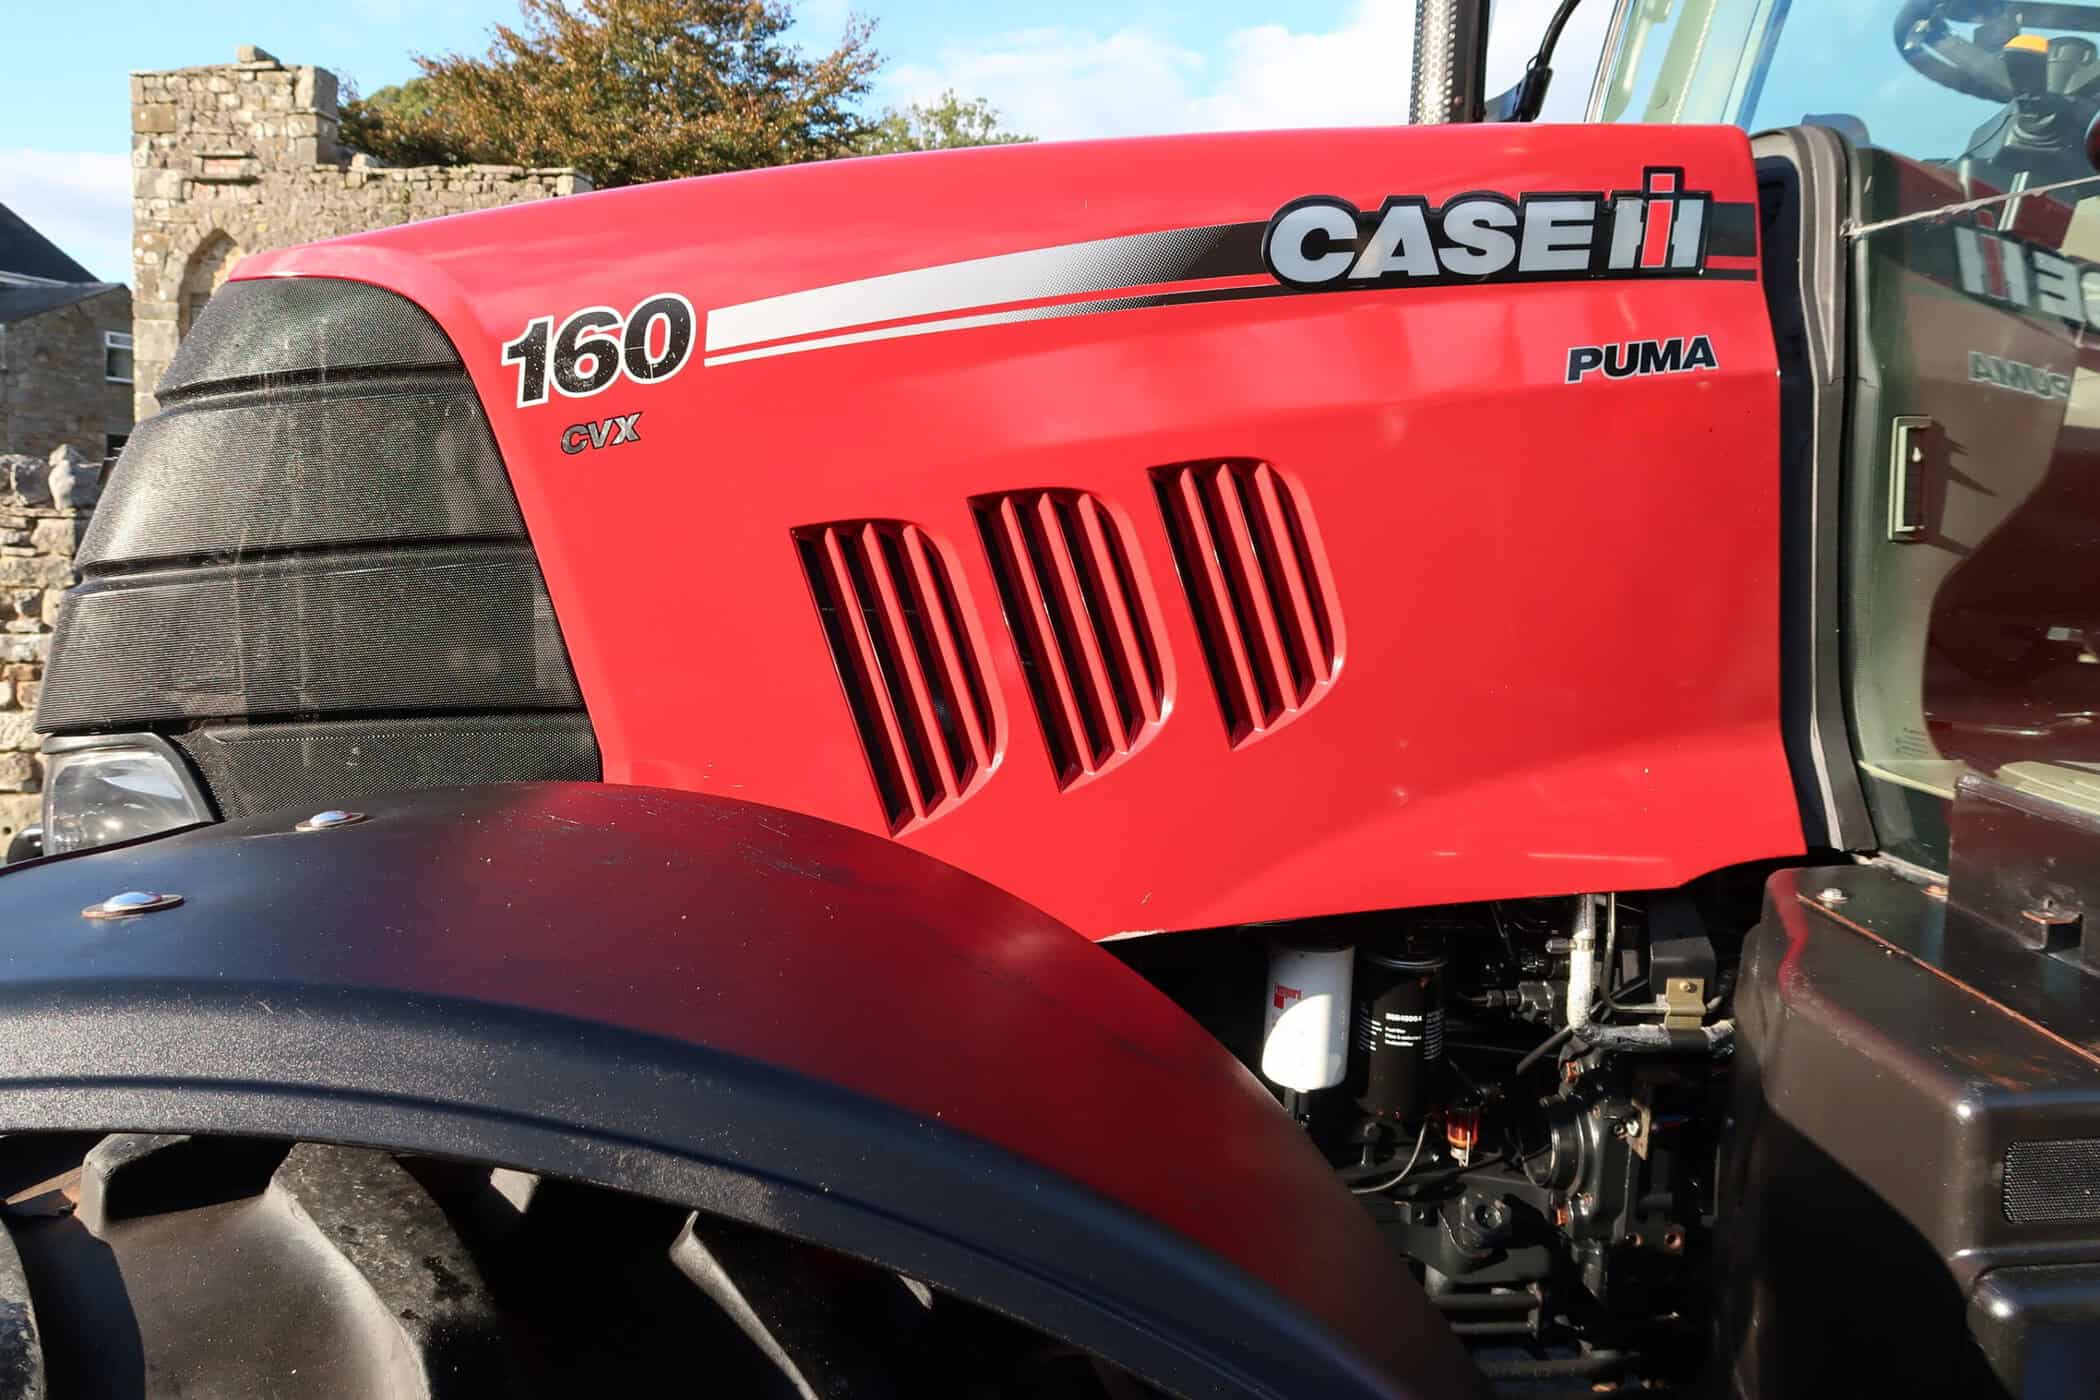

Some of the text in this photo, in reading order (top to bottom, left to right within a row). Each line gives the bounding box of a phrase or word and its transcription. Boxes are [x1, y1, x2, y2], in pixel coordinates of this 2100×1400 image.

[1267, 197, 1597, 284] CASE
[501, 292, 696, 408] 160
[1564, 335, 1719, 385] PUMA
[560, 411, 643, 455] CVX
